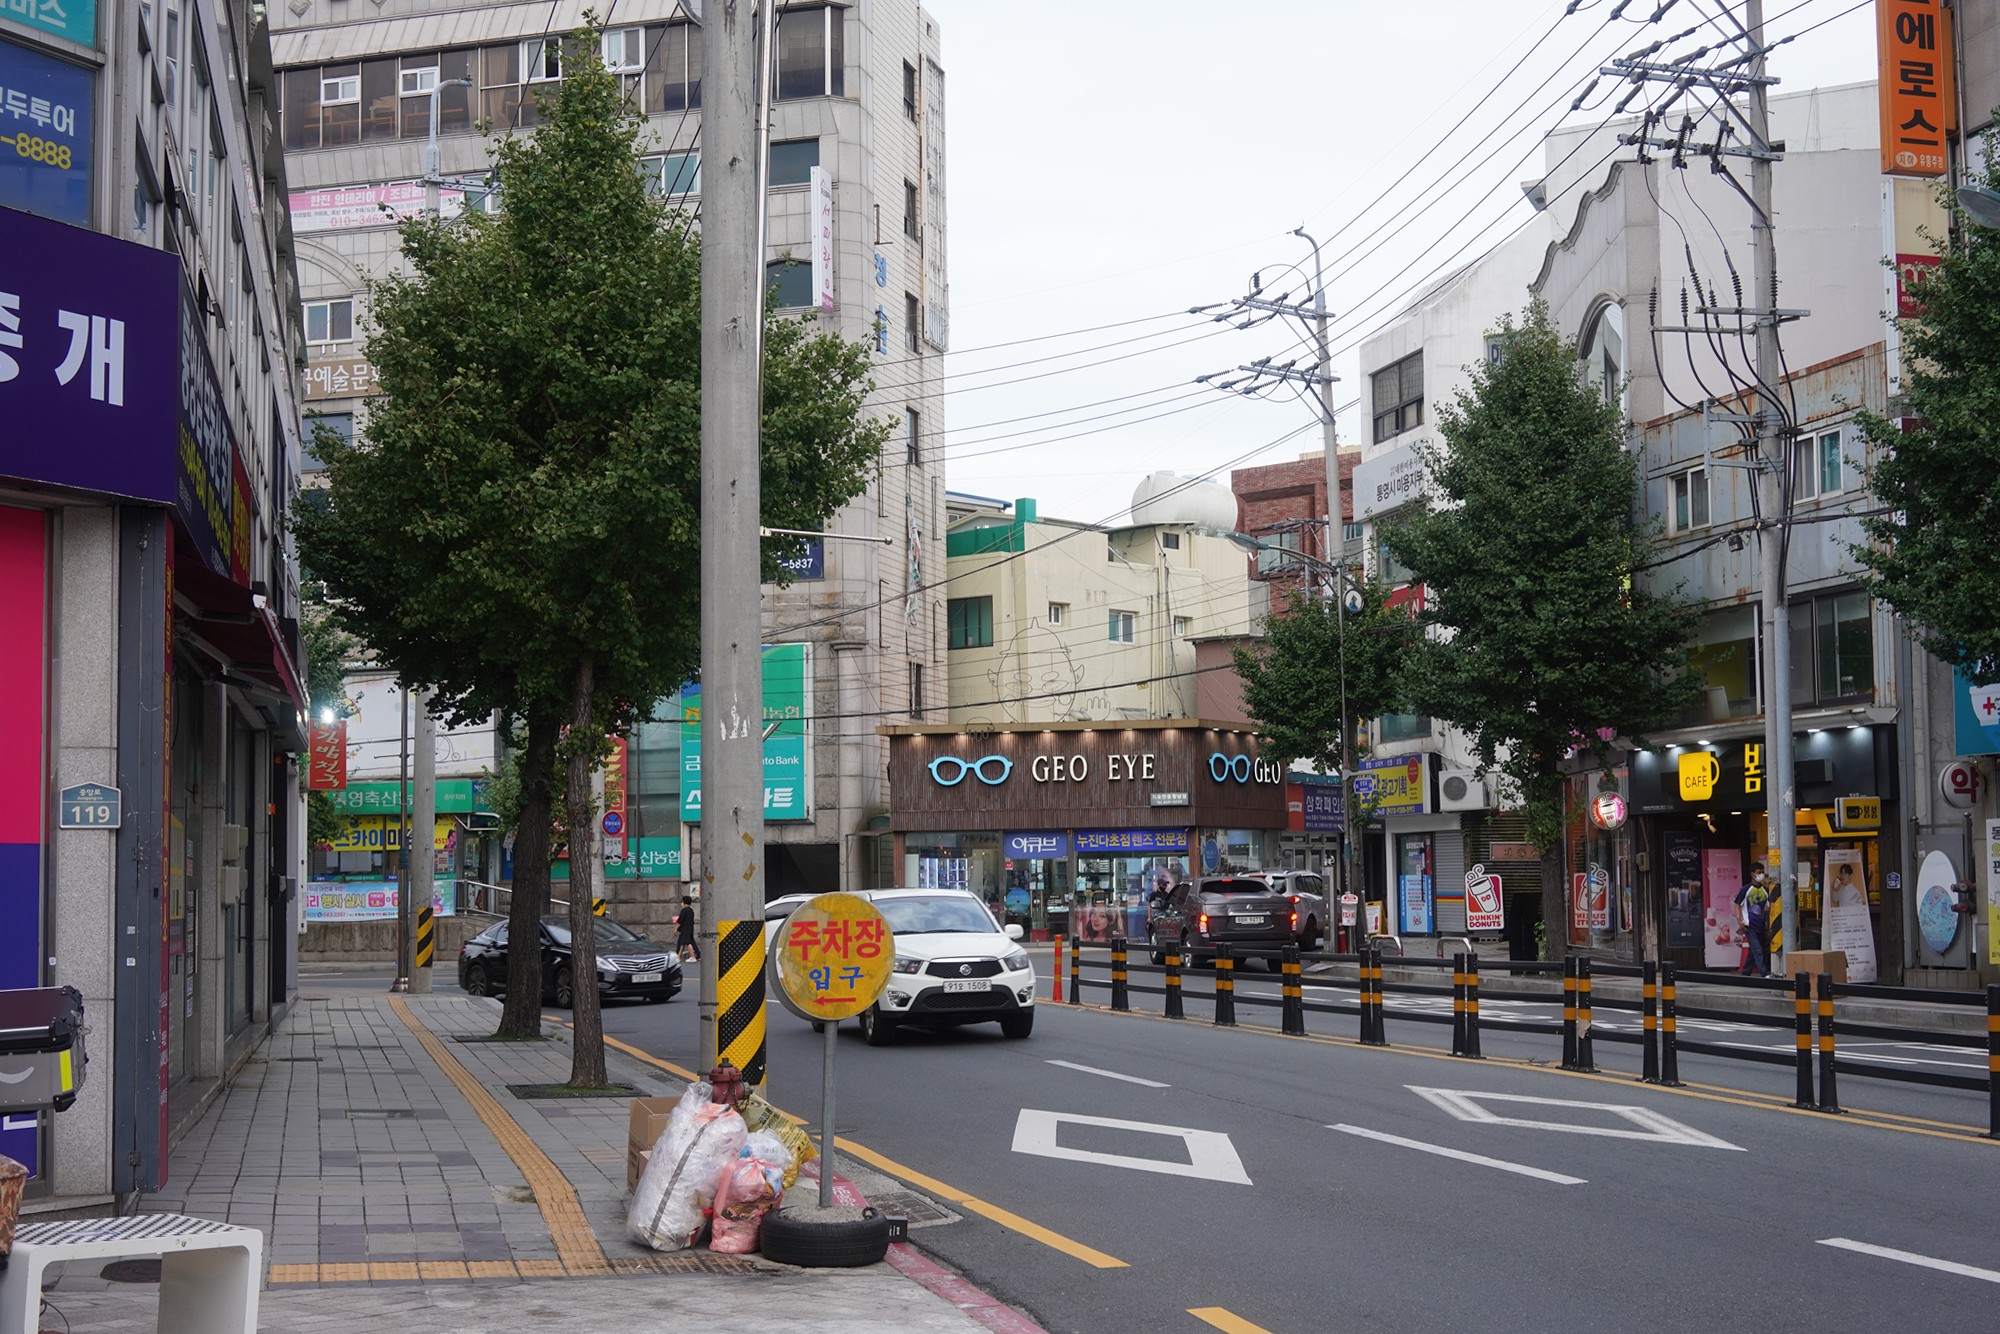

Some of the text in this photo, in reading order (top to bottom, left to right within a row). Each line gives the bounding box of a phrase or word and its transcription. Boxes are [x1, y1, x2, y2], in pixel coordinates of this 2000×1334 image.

[1895, 0, 1939, 146] 에로스
[0, 86, 75, 137] 두투어
[310, 193, 330, 207] 한진
[335, 189, 375, 205] 인테리어
[775, 756, 799, 765] Bank
[1031, 754, 1156, 782] GEO EYE
[1254, 757, 1282, 785] GEO
[1685, 775, 1708, 788] CAFE
[79, 789, 102, 797] 중앙로
[71, 805, 110, 823] 119
[1012, 836, 1057, 854] 아큐브
[1077, 833, 1187, 848] 누진다초점 렌즈 전문점
[1670, 848, 1698, 858] Bubble
[321, 893, 343, 909] 행사
[345, 893, 366, 908] 실시
[788, 919, 885, 961] 주차장
[967, 981, 987, 990] 1508
